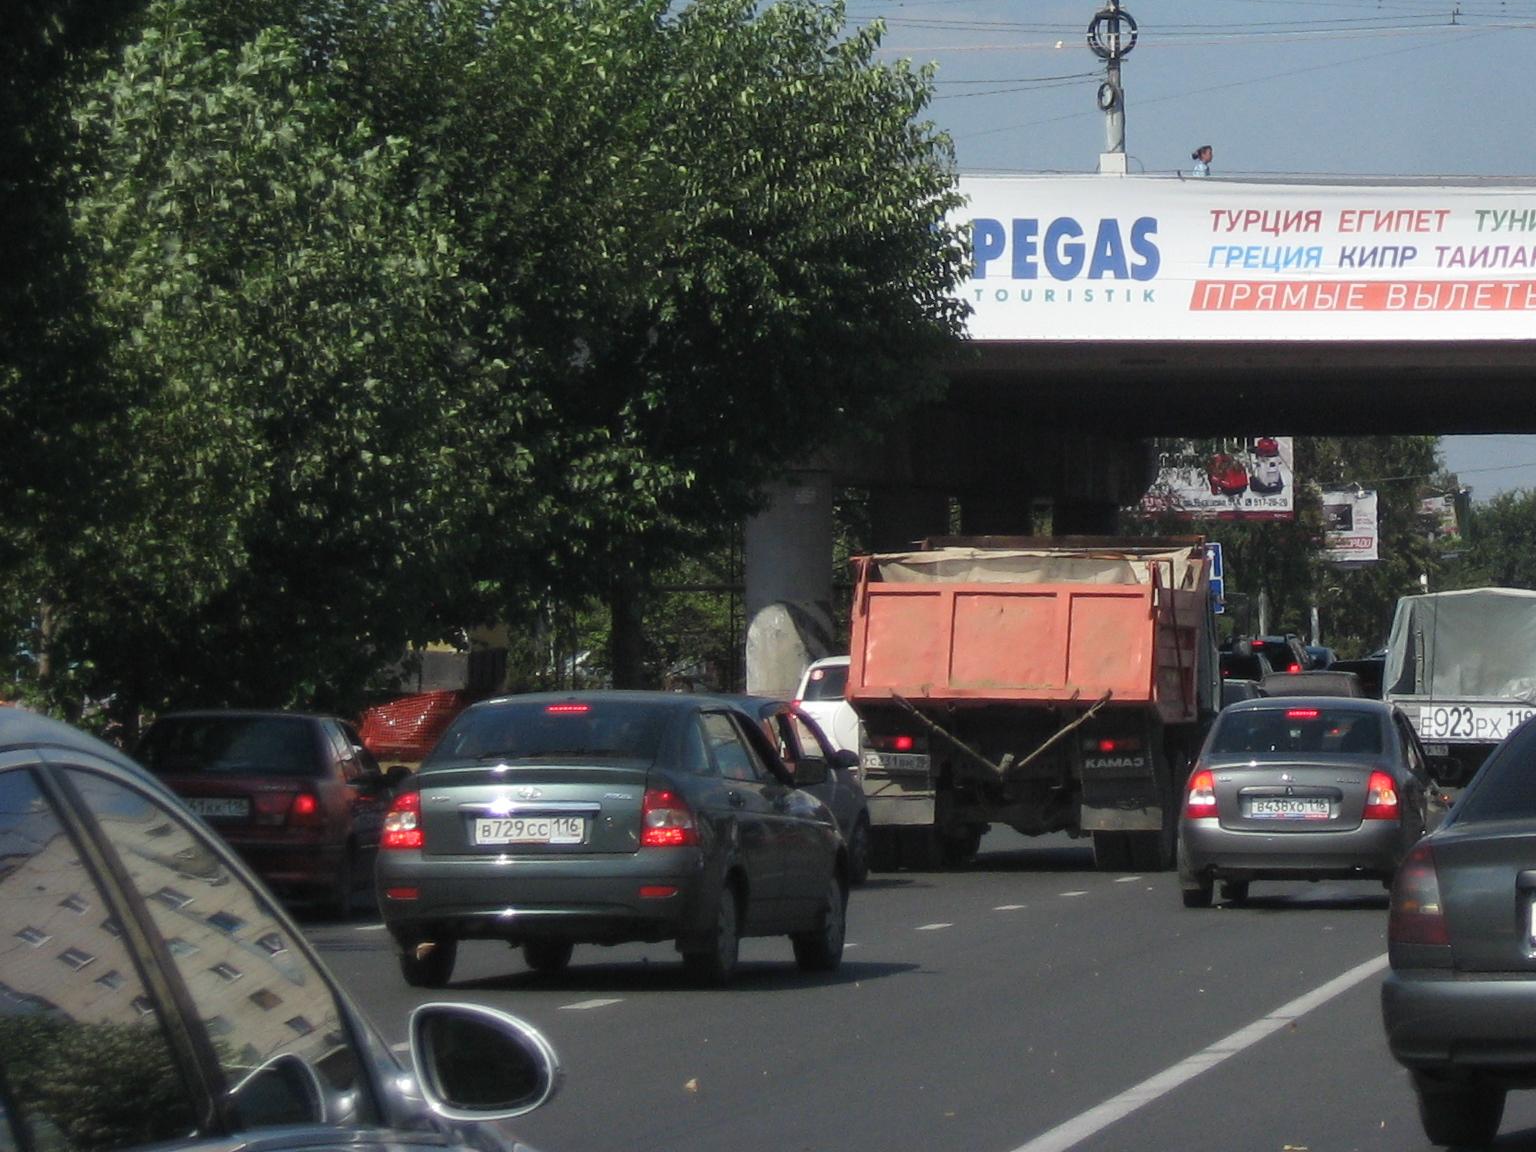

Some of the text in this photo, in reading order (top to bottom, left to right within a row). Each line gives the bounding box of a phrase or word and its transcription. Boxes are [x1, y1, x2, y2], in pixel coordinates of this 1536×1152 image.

[1210, 209, 1323, 237] ТУРЦИЯ
[1338, 209, 1451, 233] ЕГИПЕТ
[972, 216, 1161, 282] PEGAS
[1207, 245, 1324, 273] ГРЕЦИЯ
[1338, 245, 1418, 268] КИПР
[974, 288, 1156, 303] TOURISTIK
[1201, 283, 1367, 310] ПРЯМЫЕ
[1085, 757, 1145, 769] КАМАЗ
